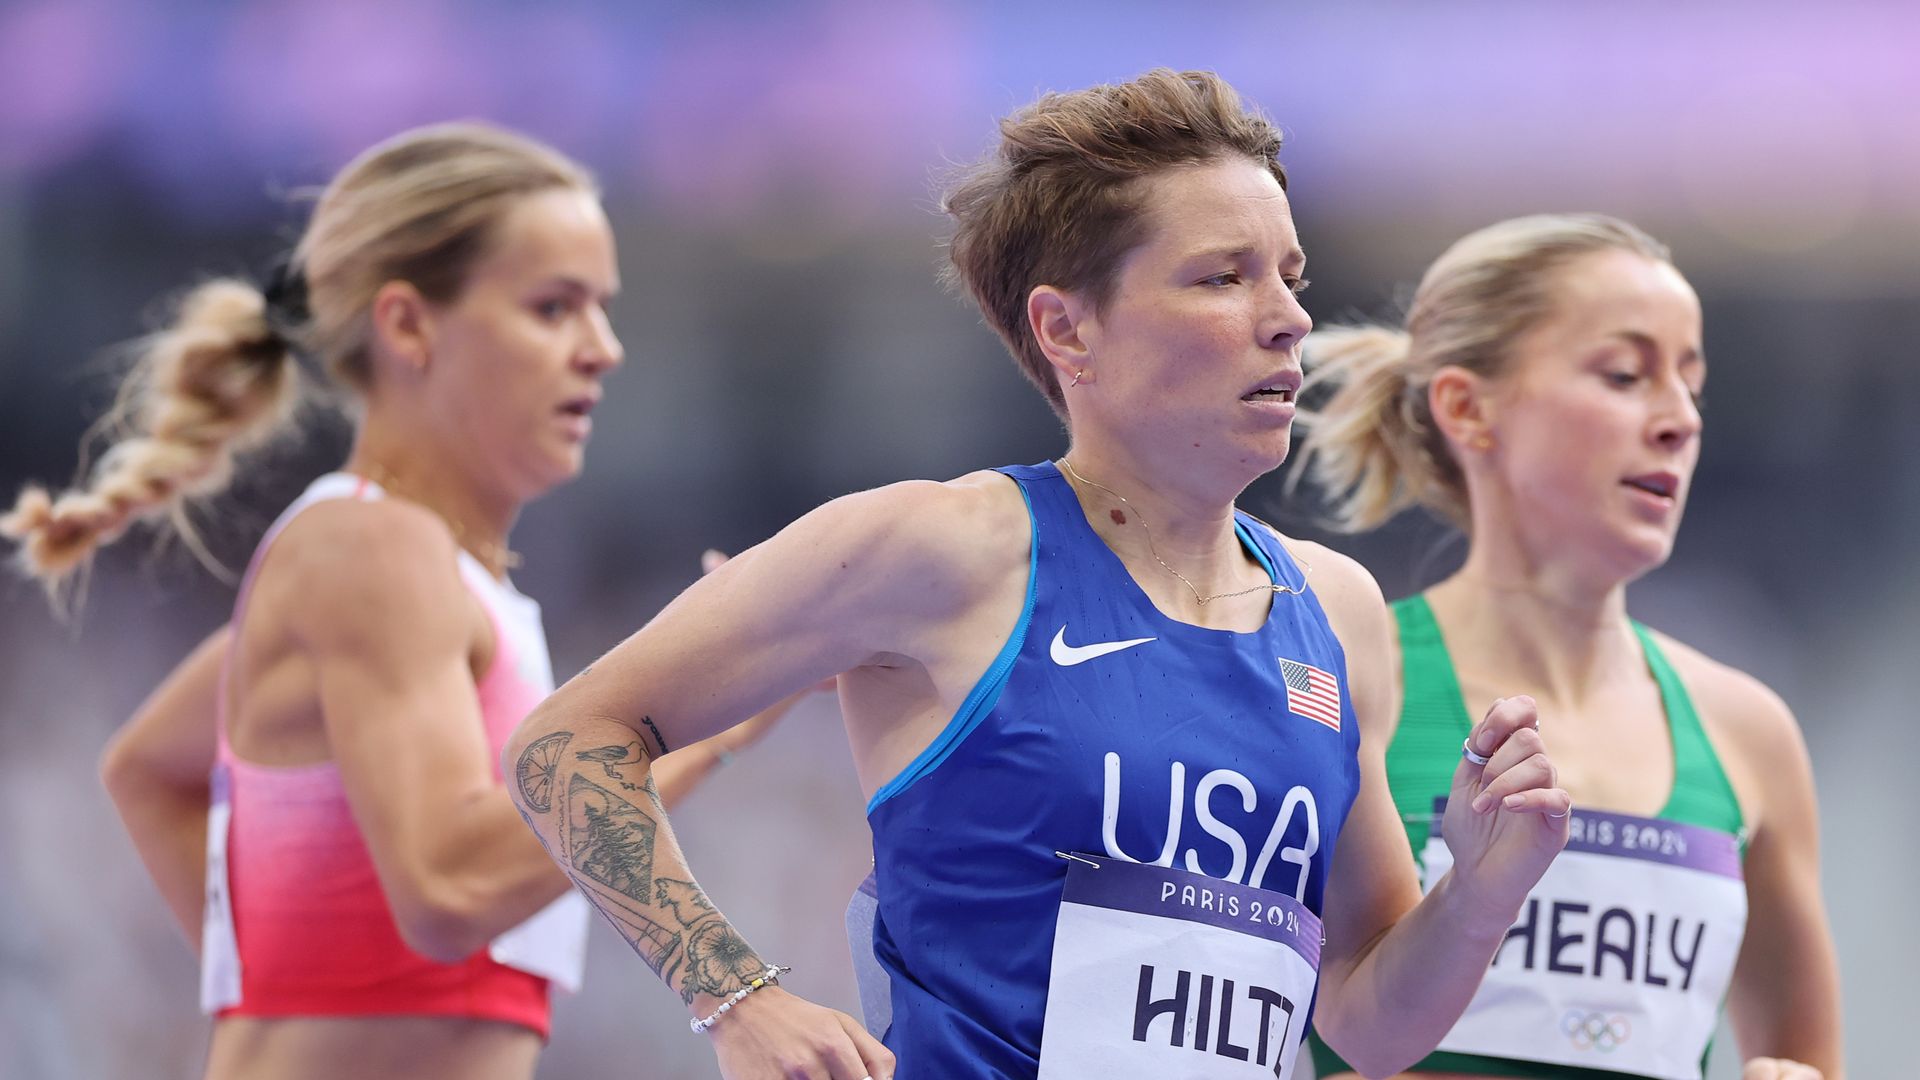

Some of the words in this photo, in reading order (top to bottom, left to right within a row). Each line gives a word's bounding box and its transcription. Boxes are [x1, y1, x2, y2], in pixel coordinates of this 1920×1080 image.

[1102, 752, 1319, 900] USA
[1621, 823, 1687, 857] 2024
[1250, 901, 1299, 936] 2024
[1491, 899, 1705, 990] HEALY
